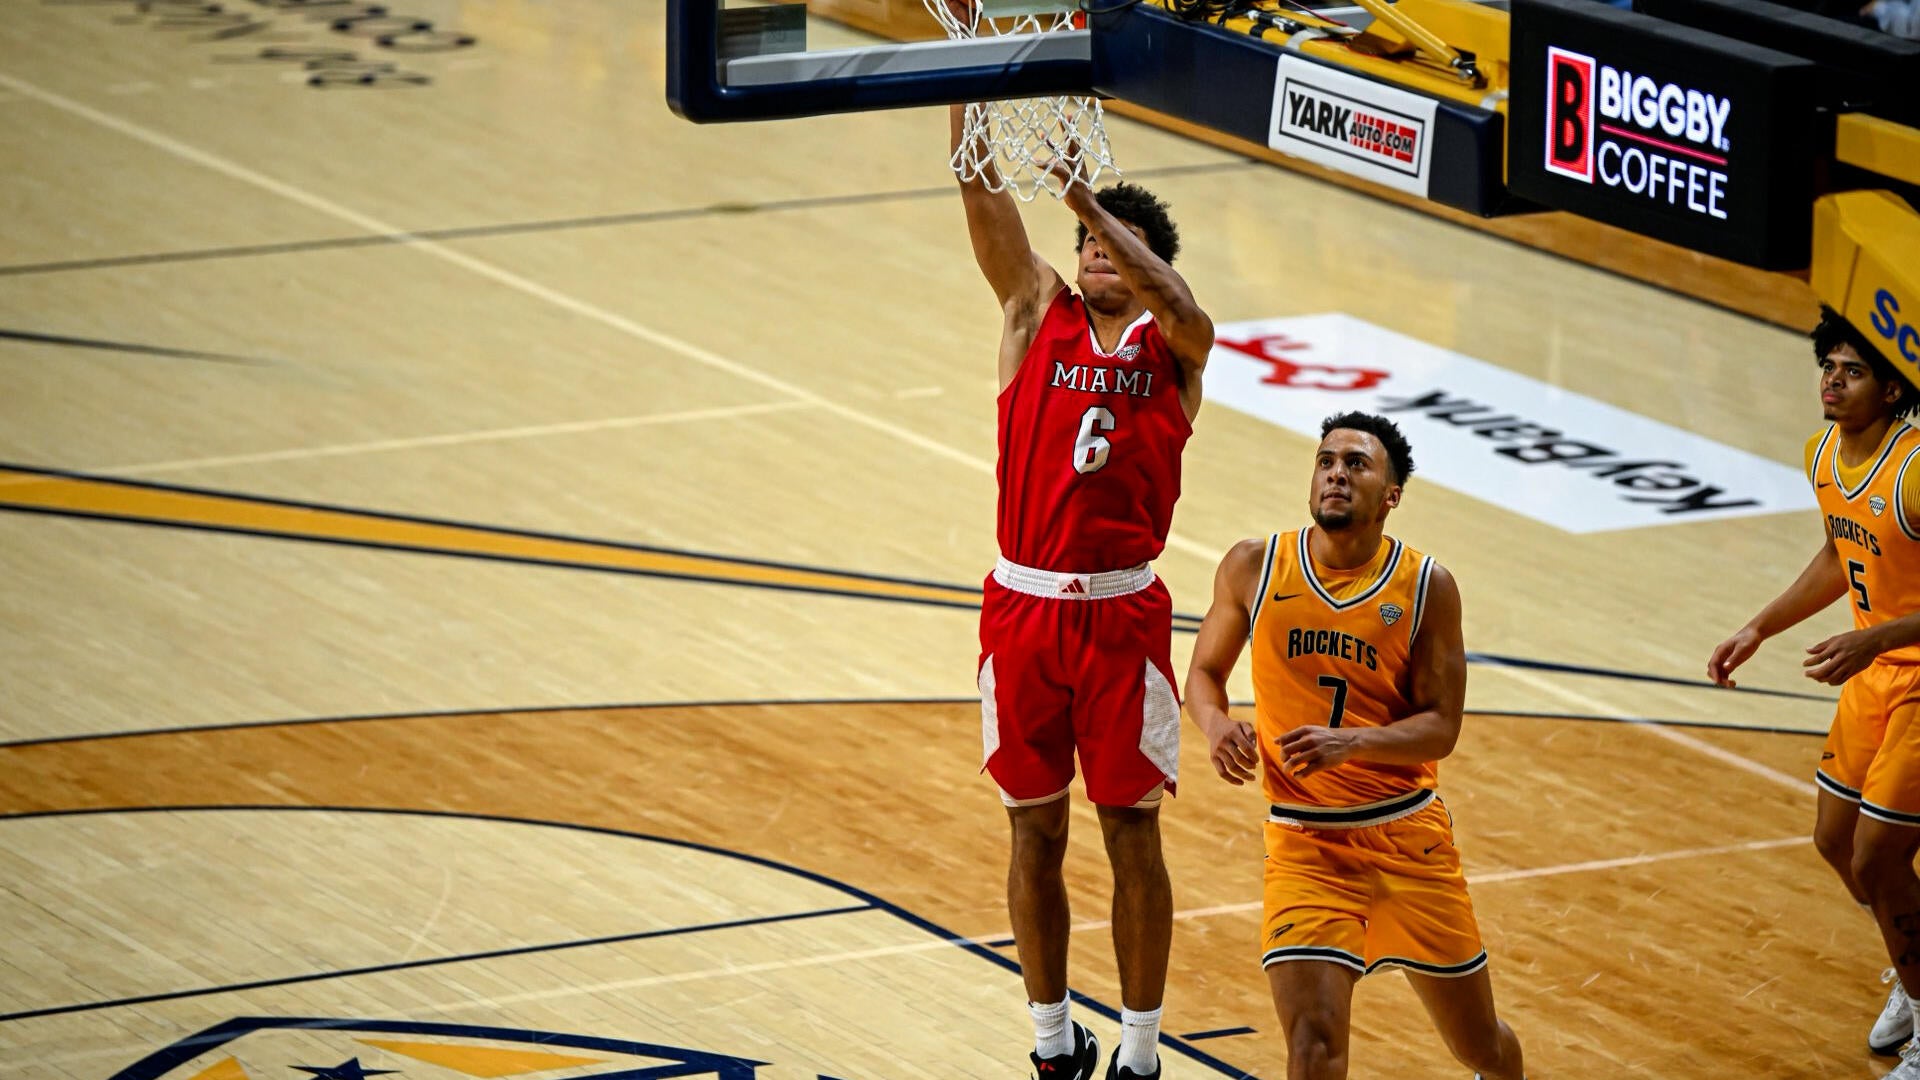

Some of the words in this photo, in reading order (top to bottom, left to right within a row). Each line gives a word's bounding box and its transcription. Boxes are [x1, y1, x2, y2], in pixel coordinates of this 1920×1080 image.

[1288, 90, 1351, 142] YARK
[1349, 121, 1412, 153] AUTO.COM
[1555, 62, 1583, 162] B
[1600, 66, 1730, 148] BIGGBY
[1598, 141, 1728, 219] COFFEE
[1869, 288, 1920, 368] Sc
[1050, 361, 1153, 397] MIAMI
[1072, 405, 1115, 475] 6
[1378, 390, 1761, 515] KeyBank
[1827, 513, 1882, 557] ROCKETS
[1847, 558, 1872, 613] 5
[1287, 628, 1378, 673] ROCKETS
[1317, 674, 1349, 729] 7
